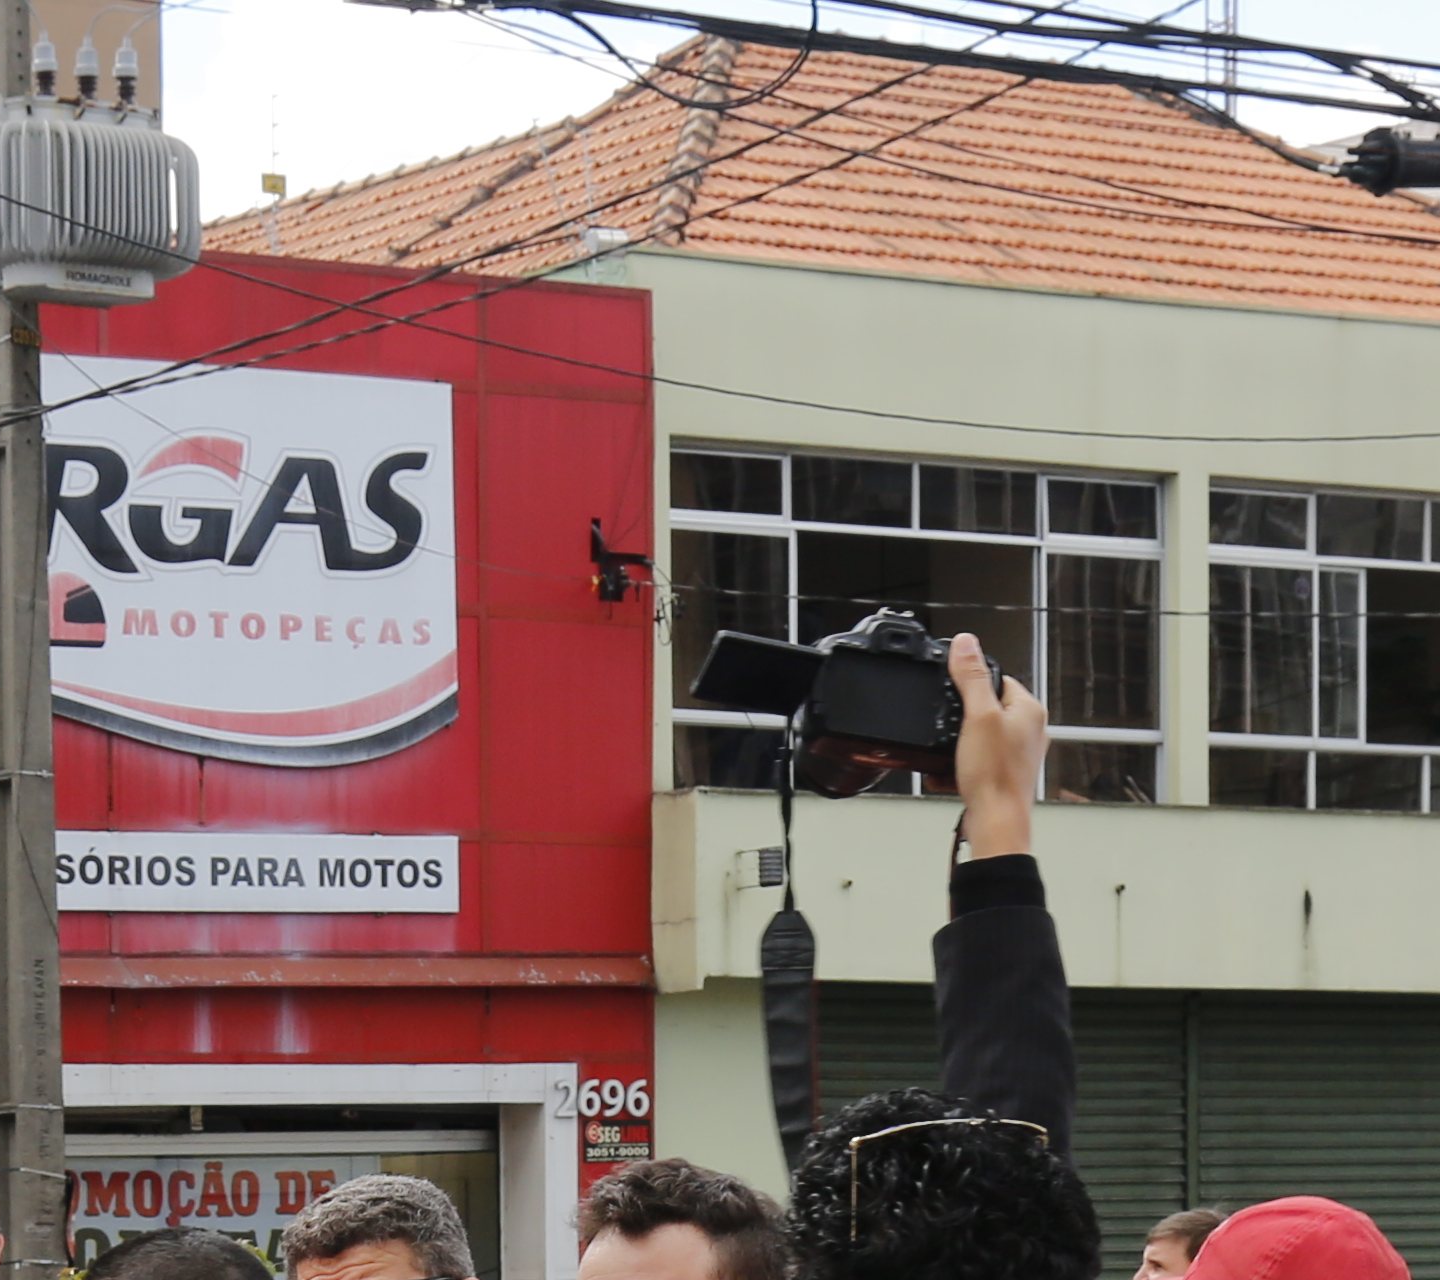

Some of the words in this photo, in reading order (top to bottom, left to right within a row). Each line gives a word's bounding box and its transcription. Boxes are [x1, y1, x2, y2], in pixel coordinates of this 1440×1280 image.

[122, 607, 434, 650] MOTOPEÇAS
[212, 856, 306, 888] PARA
[319, 857, 444, 889] MOTOS
[554, 1078, 650, 1119] 2696
[586, 1146, 650, 1159] 3051-9000
[71, 1161, 260, 1227] MOÇÃO
[275, 1170, 336, 1216] DE
